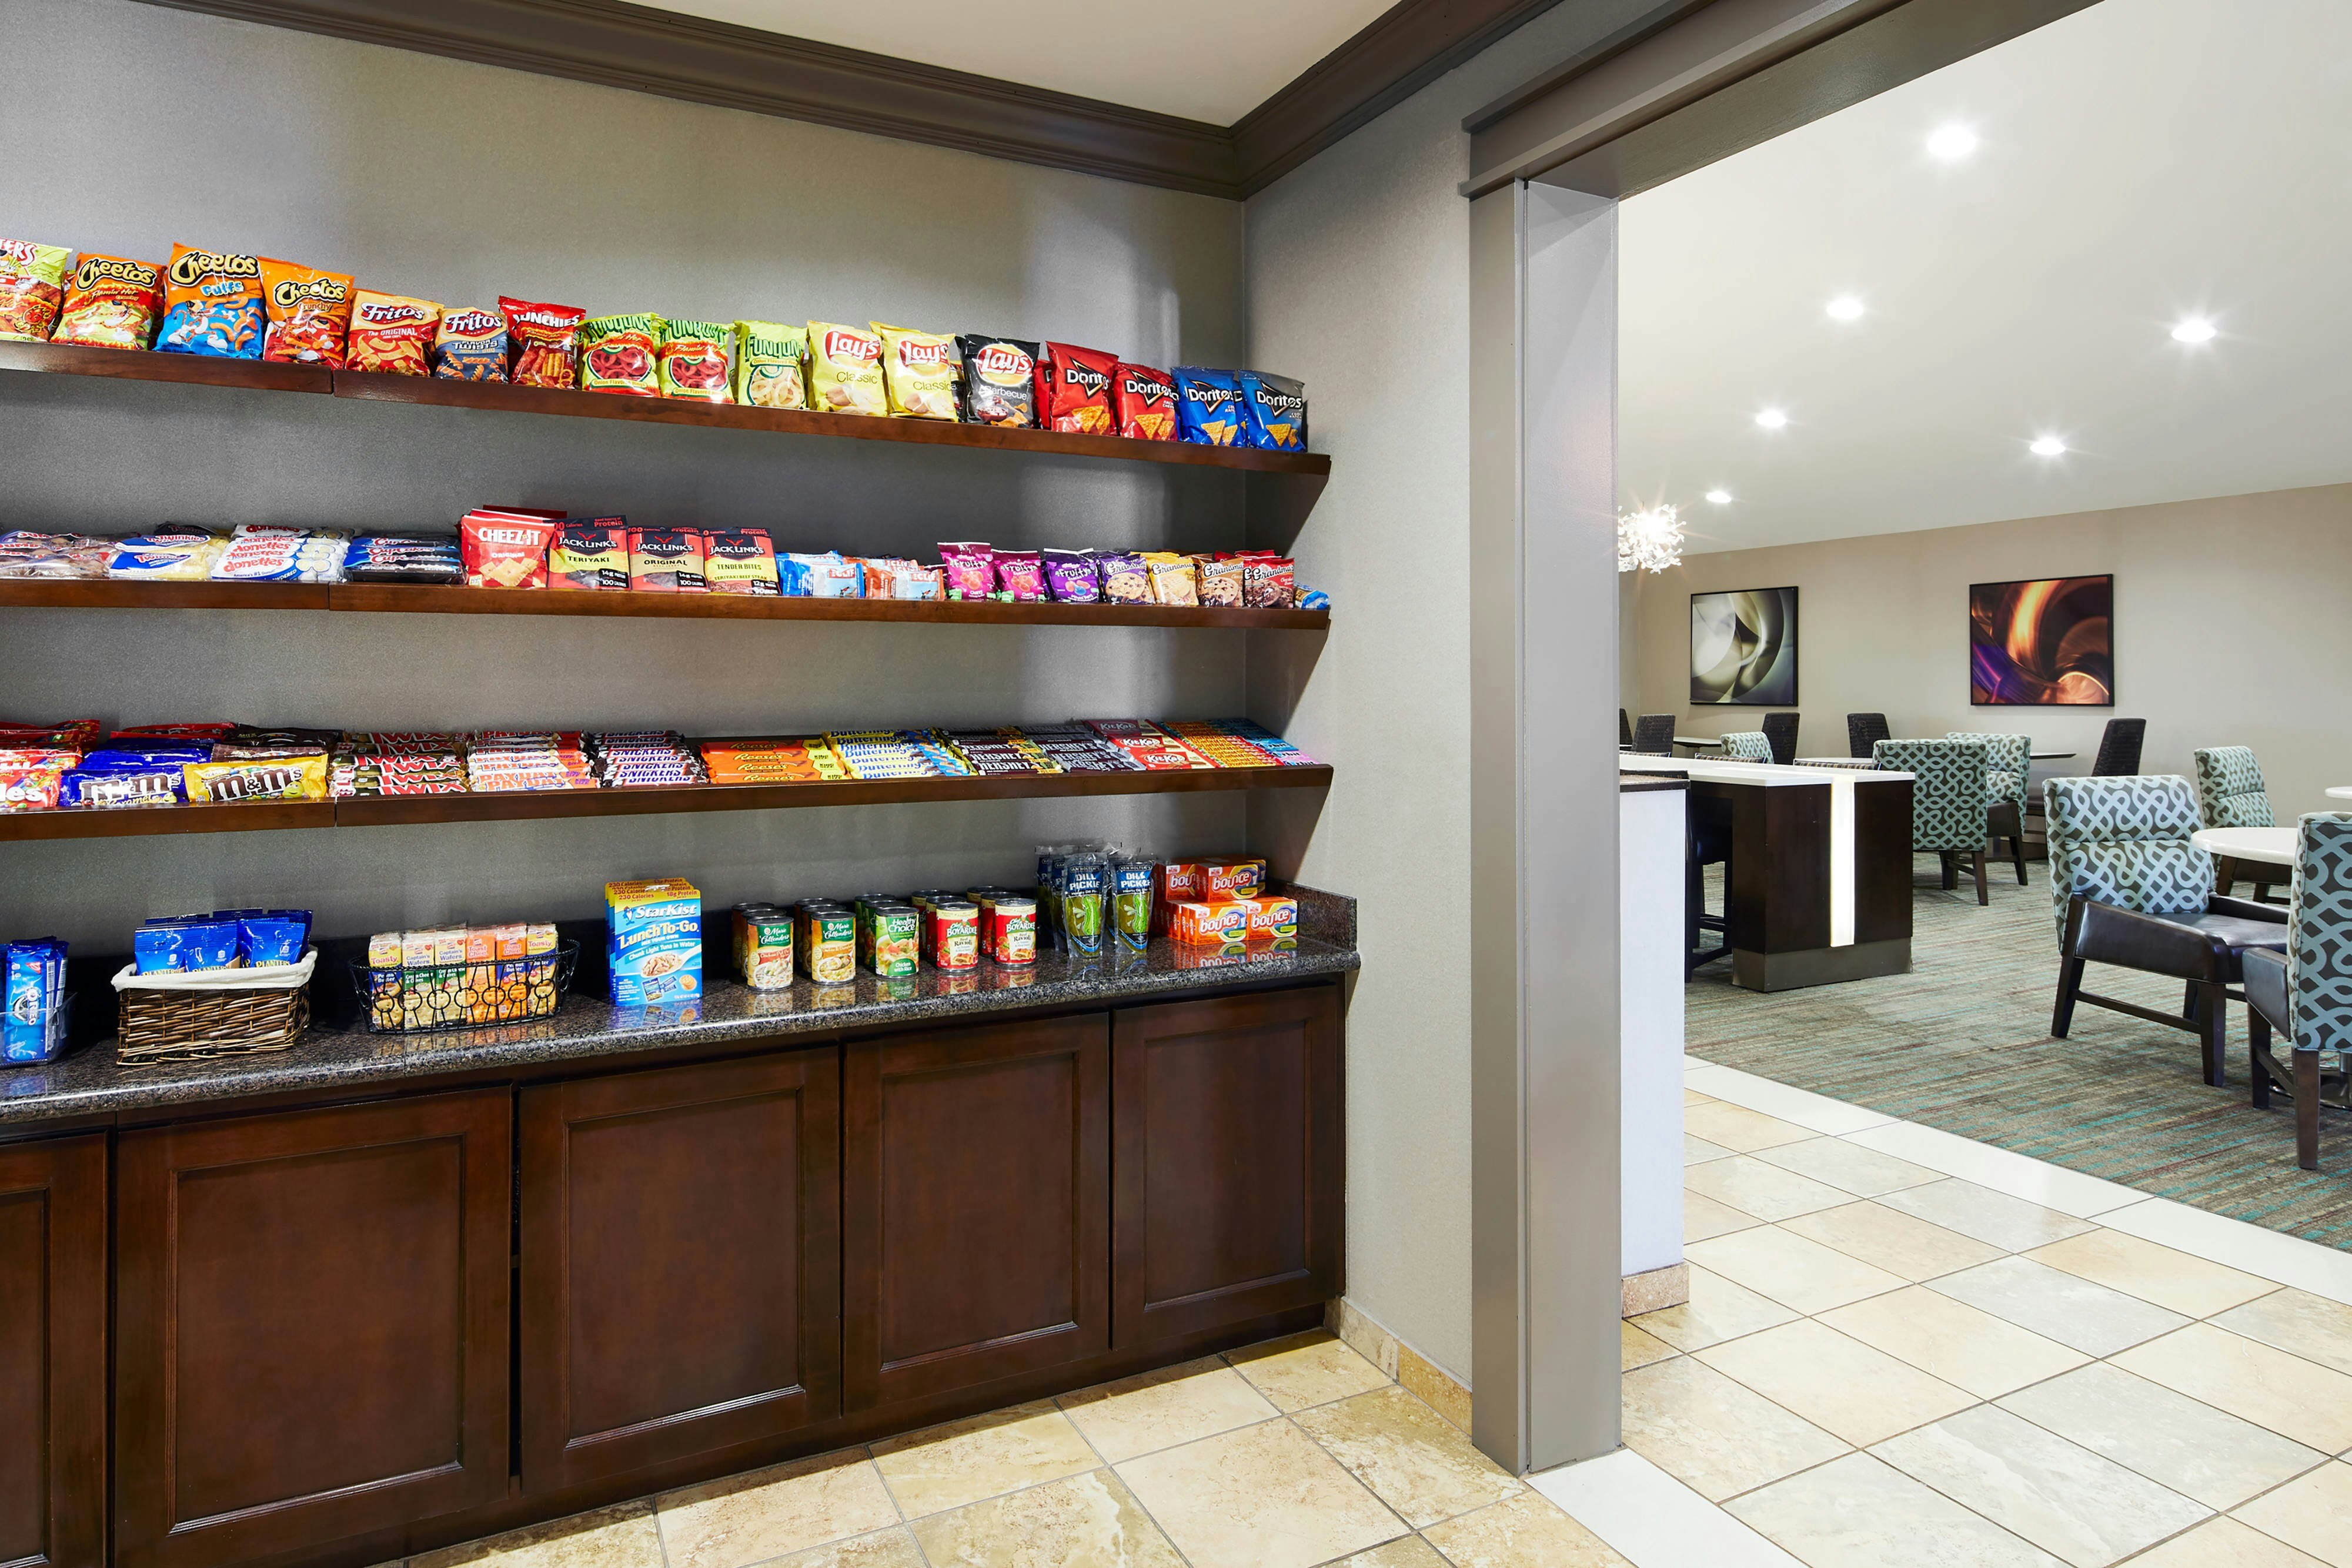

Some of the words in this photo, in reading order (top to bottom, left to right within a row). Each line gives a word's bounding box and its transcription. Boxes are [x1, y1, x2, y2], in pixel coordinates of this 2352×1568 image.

[77, 258, 156, 290] Cheetos
[169, 252, 259, 286] Cheetos
[201, 281, 245, 296] Puffs
[275, 279, 347, 306] Cheetos
[299, 302, 332, 312] Crunchy
[361, 302, 425, 320] Fritos
[445, 312, 503, 333] Fritos
[380, 327, 417, 336] ORIGINAL
[453, 340, 498, 350] TWISTS
[674, 344, 703, 352] Flamin'
[829, 332, 881, 360] Lay's
[902, 340, 948, 365] Lay's
[980, 347, 1030, 376] Lay's
[836, 371, 878, 385] Classic
[1067, 369, 1110, 390] Doritos
[913, 381, 951, 392] Classic
[982, 385, 1027, 400] Barbecue
[1126, 379, 1174, 400] Doritos
[1188, 388, 1233, 402] Doritos
[1257, 391, 1302, 409] Doritos
[479, 529, 541, 546] CHEEZ-IT
[559, 537, 586, 547] JACK
[635, 543, 663, 551] JACK
[709, 546, 735, 556] JACK
[223, 557, 284, 572] donettes
[1058, 568, 1089, 578] Fruity
[1038, 743, 1098, 751] HERSHEY'S
[355, 754, 437, 767] TWIX
[733, 753, 784, 761] Reese's
[1050, 750, 1112, 761] HERSHEY'S
[1147, 755, 1186, 763] KitKat
[737, 763, 788, 771] Reese's
[206, 766, 303, 802] m&m's
[743, 773, 795, 781] Reese's
[381, 782, 467, 795] TWIX
[1212, 871, 1252, 892] bounce
[635, 903, 697, 919] StarKist
[892, 917, 916, 926] Healthy
[1199, 913, 1240, 935] bounce
[1251, 909, 1292, 931] bounce
[888, 924, 915, 933] Choice
[616, 924, 661, 950] Lunch
[370, 955, 397, 965] Toasty
[629, 951, 646, 961] Chunk
[646, 945, 660, 956] Light
[255, 959, 291, 968] PLANTERS
[25, 987, 39, 1026] OREO
